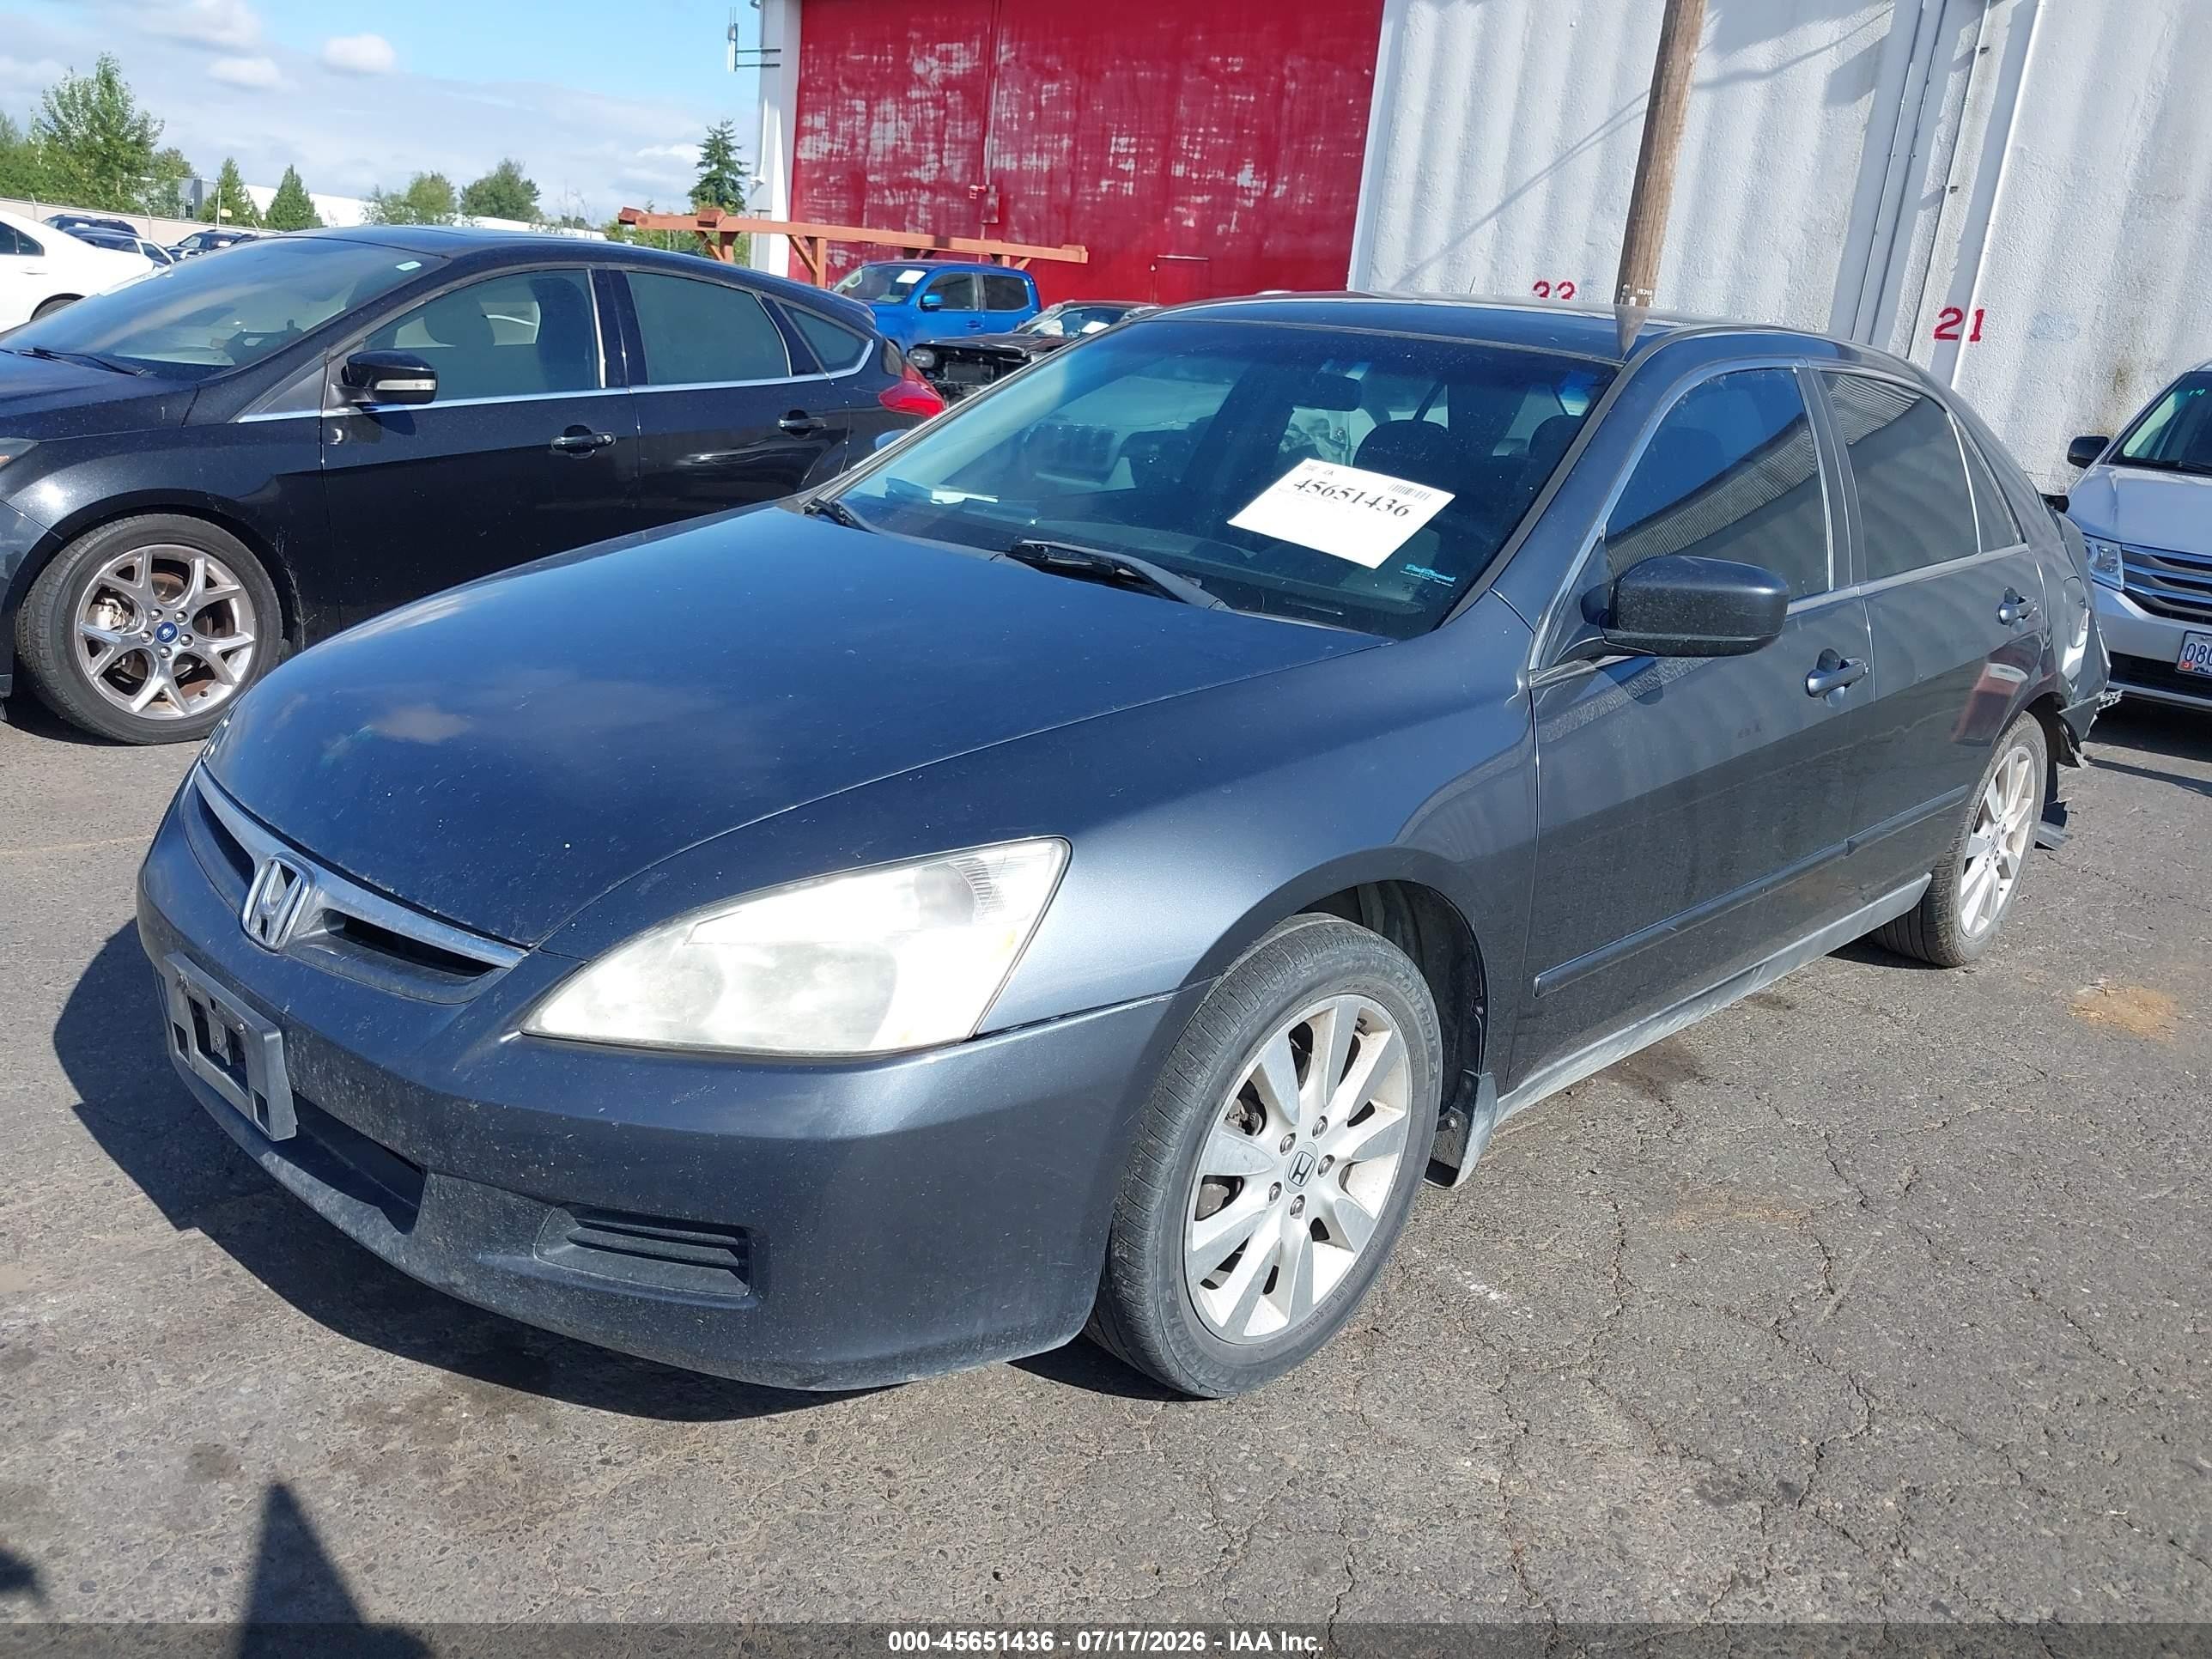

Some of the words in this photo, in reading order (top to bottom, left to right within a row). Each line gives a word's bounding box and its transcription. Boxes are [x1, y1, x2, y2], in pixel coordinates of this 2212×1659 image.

[1934, 307, 1984, 342] 21
[1293, 477, 1415, 517] 45651436
[2185, 642, 2212, 665] 08
